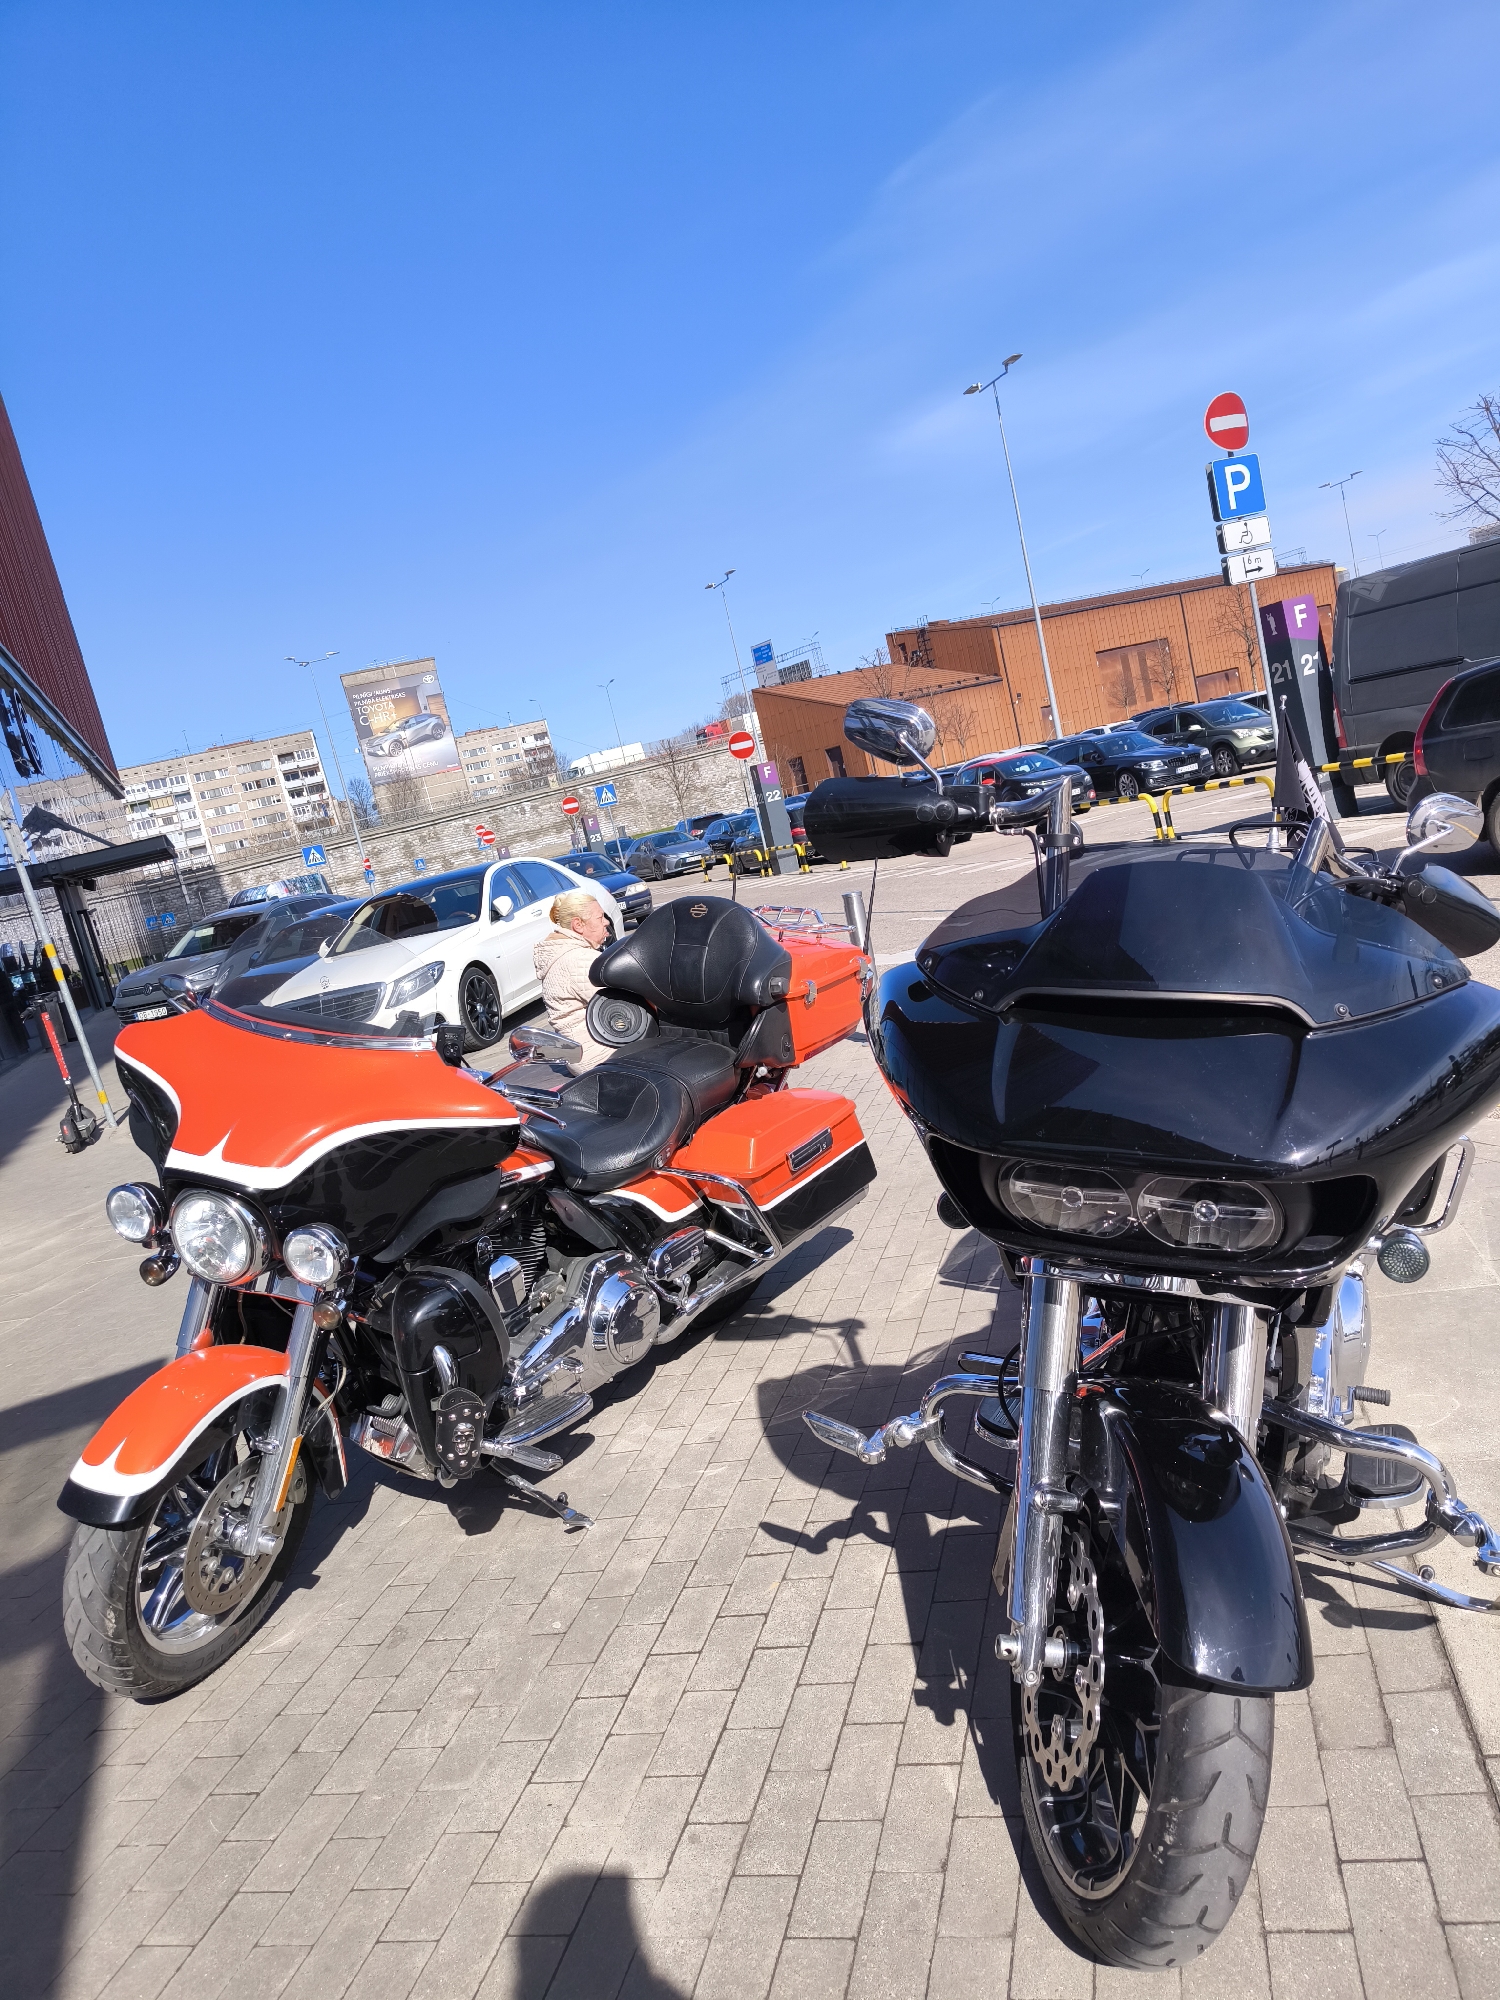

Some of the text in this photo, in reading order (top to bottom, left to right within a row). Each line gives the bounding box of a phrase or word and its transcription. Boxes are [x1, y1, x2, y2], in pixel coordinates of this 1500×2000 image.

[1224, 464, 1251, 510] P
[1247, 555, 1252, 565] 6
[1294, 603, 1308, 628] F
[1300, 650, 1324, 676] 21
[1271, 659, 1293, 684] 21
[356, 701, 395, 715] TOYOTA
[359, 711, 397, 726] C-HR+
[764, 766, 772, 779] F
[766, 789, 782, 803] 22
[588, 817, 594, 827] F
[589, 833, 602, 843] 23
